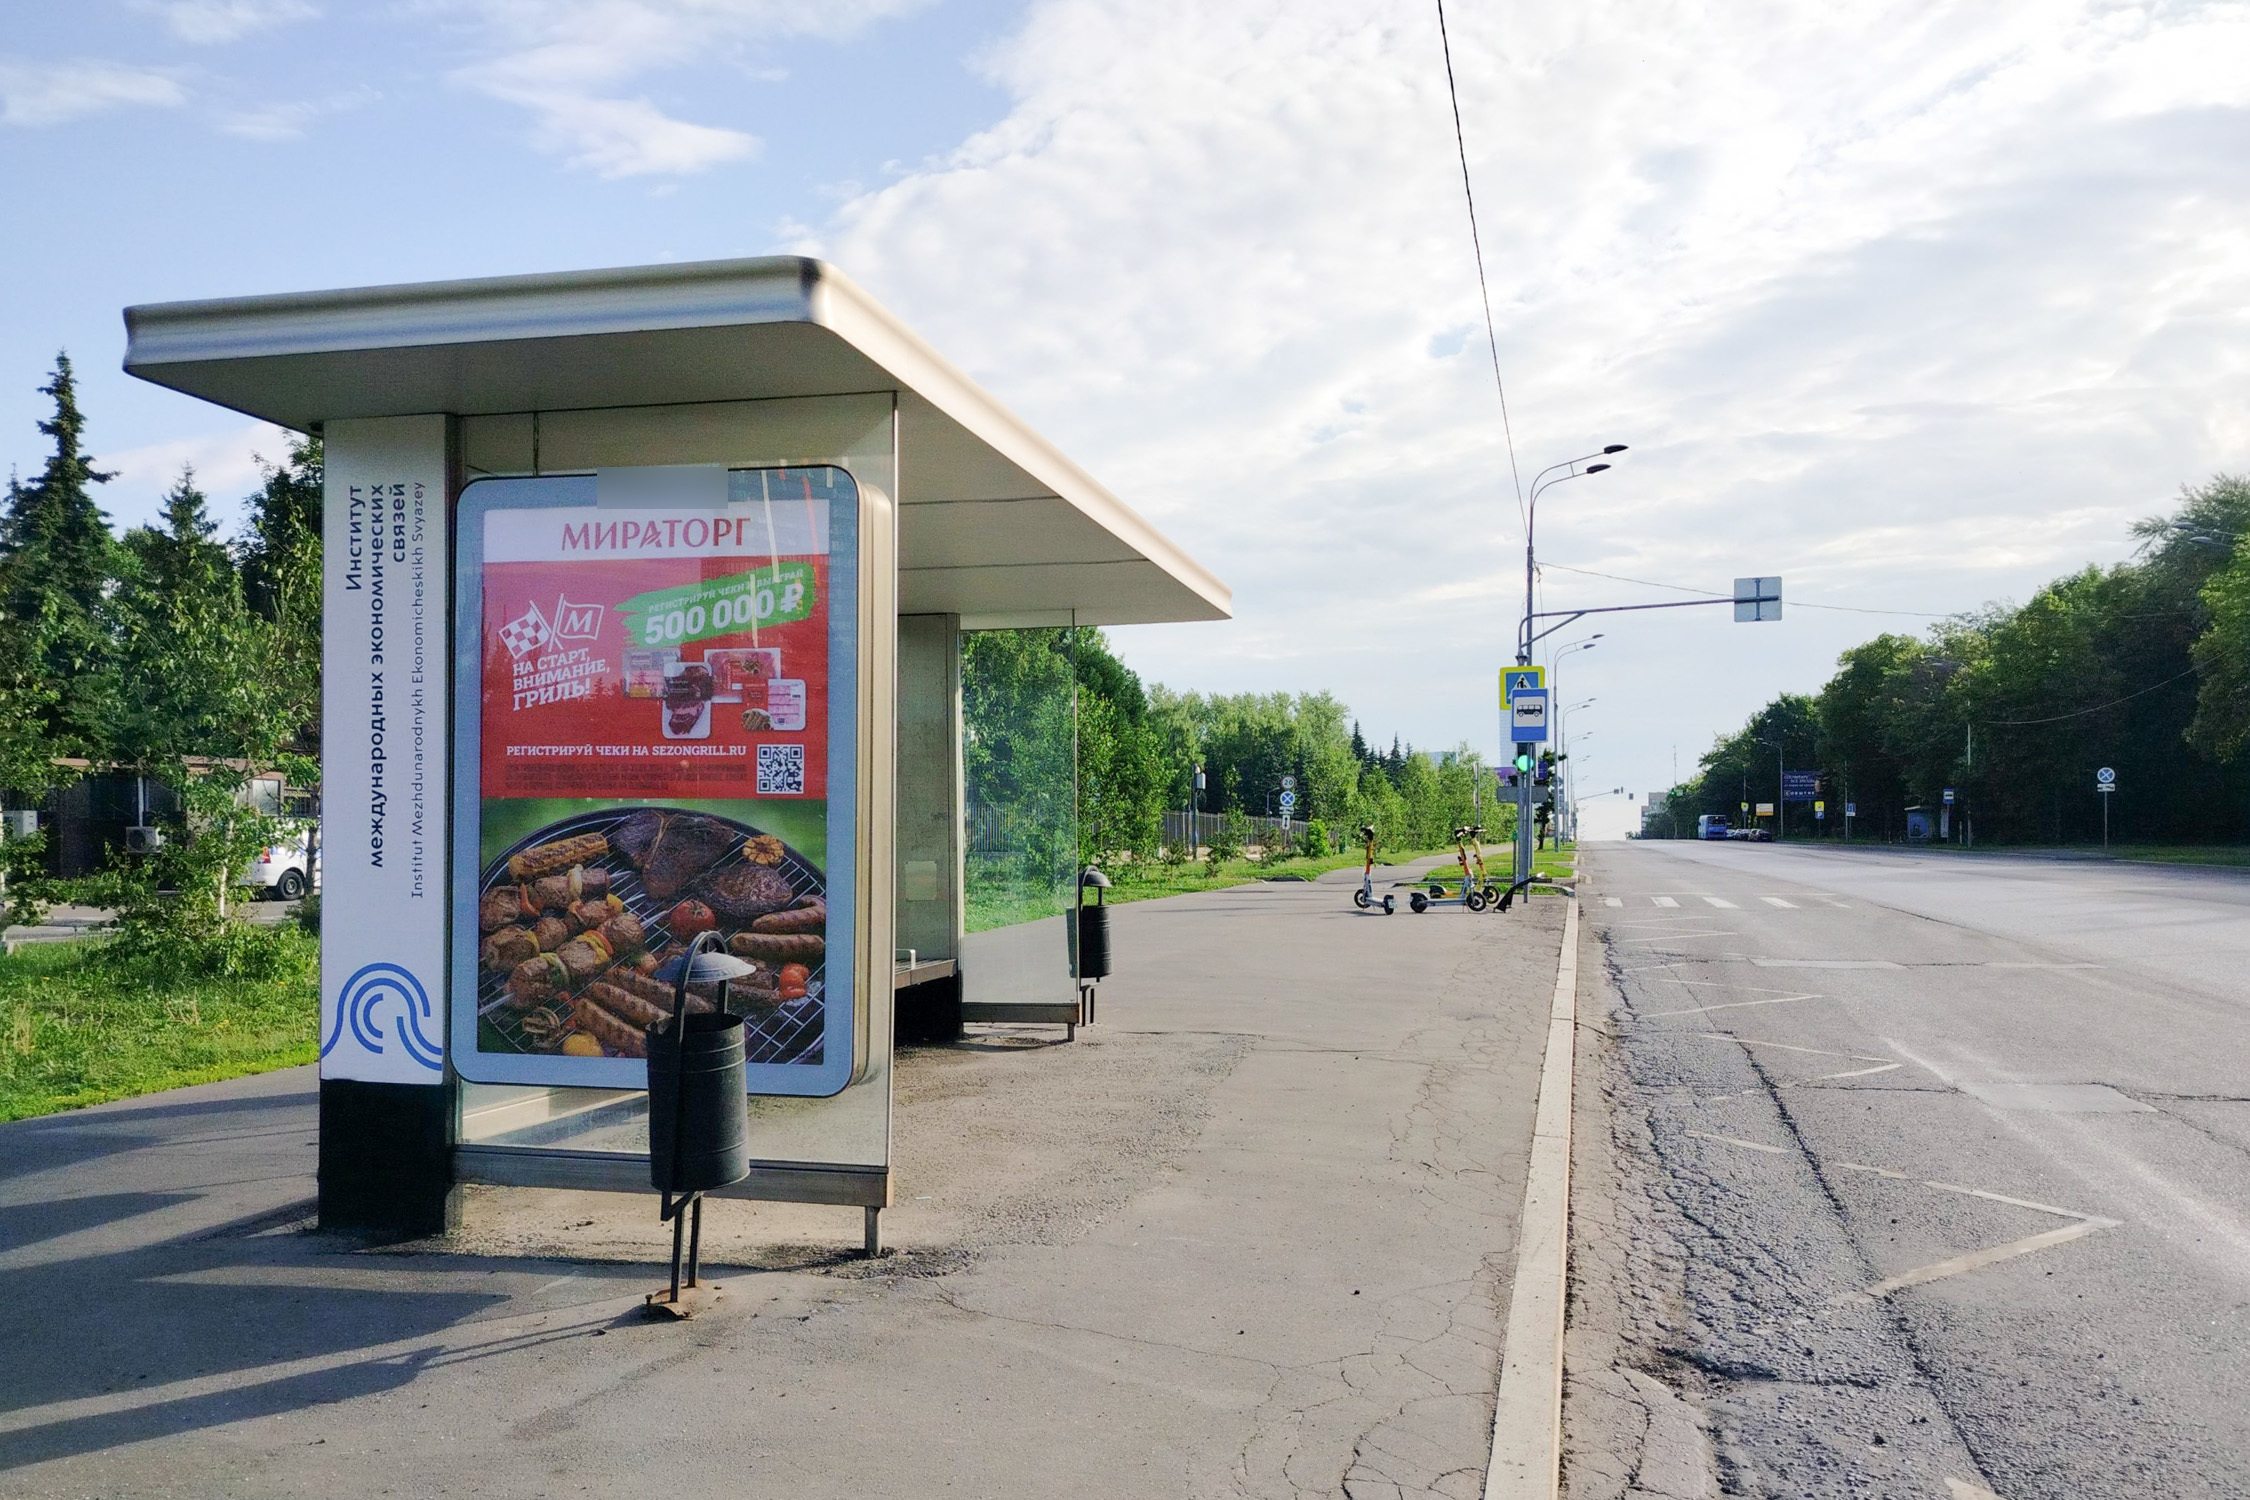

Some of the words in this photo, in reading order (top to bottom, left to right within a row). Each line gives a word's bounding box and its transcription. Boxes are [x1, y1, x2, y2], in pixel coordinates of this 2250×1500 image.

[345, 485, 366, 590] Институт
[389, 483, 406, 563] связей
[411, 482, 426, 542] Svyazey
[562, 517, 751, 551] МИРАТОРГ
[371, 484, 384, 665] экономических
[648, 589, 717, 613] РЕГИСТРИРУЙ
[718, 583, 745, 596] ЧЕКИ
[757, 568, 804, 588] ВЫГРАЙ
[411, 547, 424, 684] Ekonomicheskikh
[644, 605, 706, 645] 500
[712, 589, 775, 629] 000
[513, 660, 535, 677] НА
[537, 647, 591, 671] СТАРТ,
[513, 658, 611, 692] ВНИМАНИЕ,
[513, 677, 591, 712] ГРИЛЬ!
[371, 672, 387, 868] международных
[411, 688, 426, 836] Mezhdunarodnykh
[506, 743, 594, 756] РЕГИСТРИРУЙ
[596, 745, 630, 756] ЧЕКИ
[632, 745, 650, 756] НА
[651, 745, 748, 756] SEZONGRILL.RU
[411, 840, 424, 899] Institut
